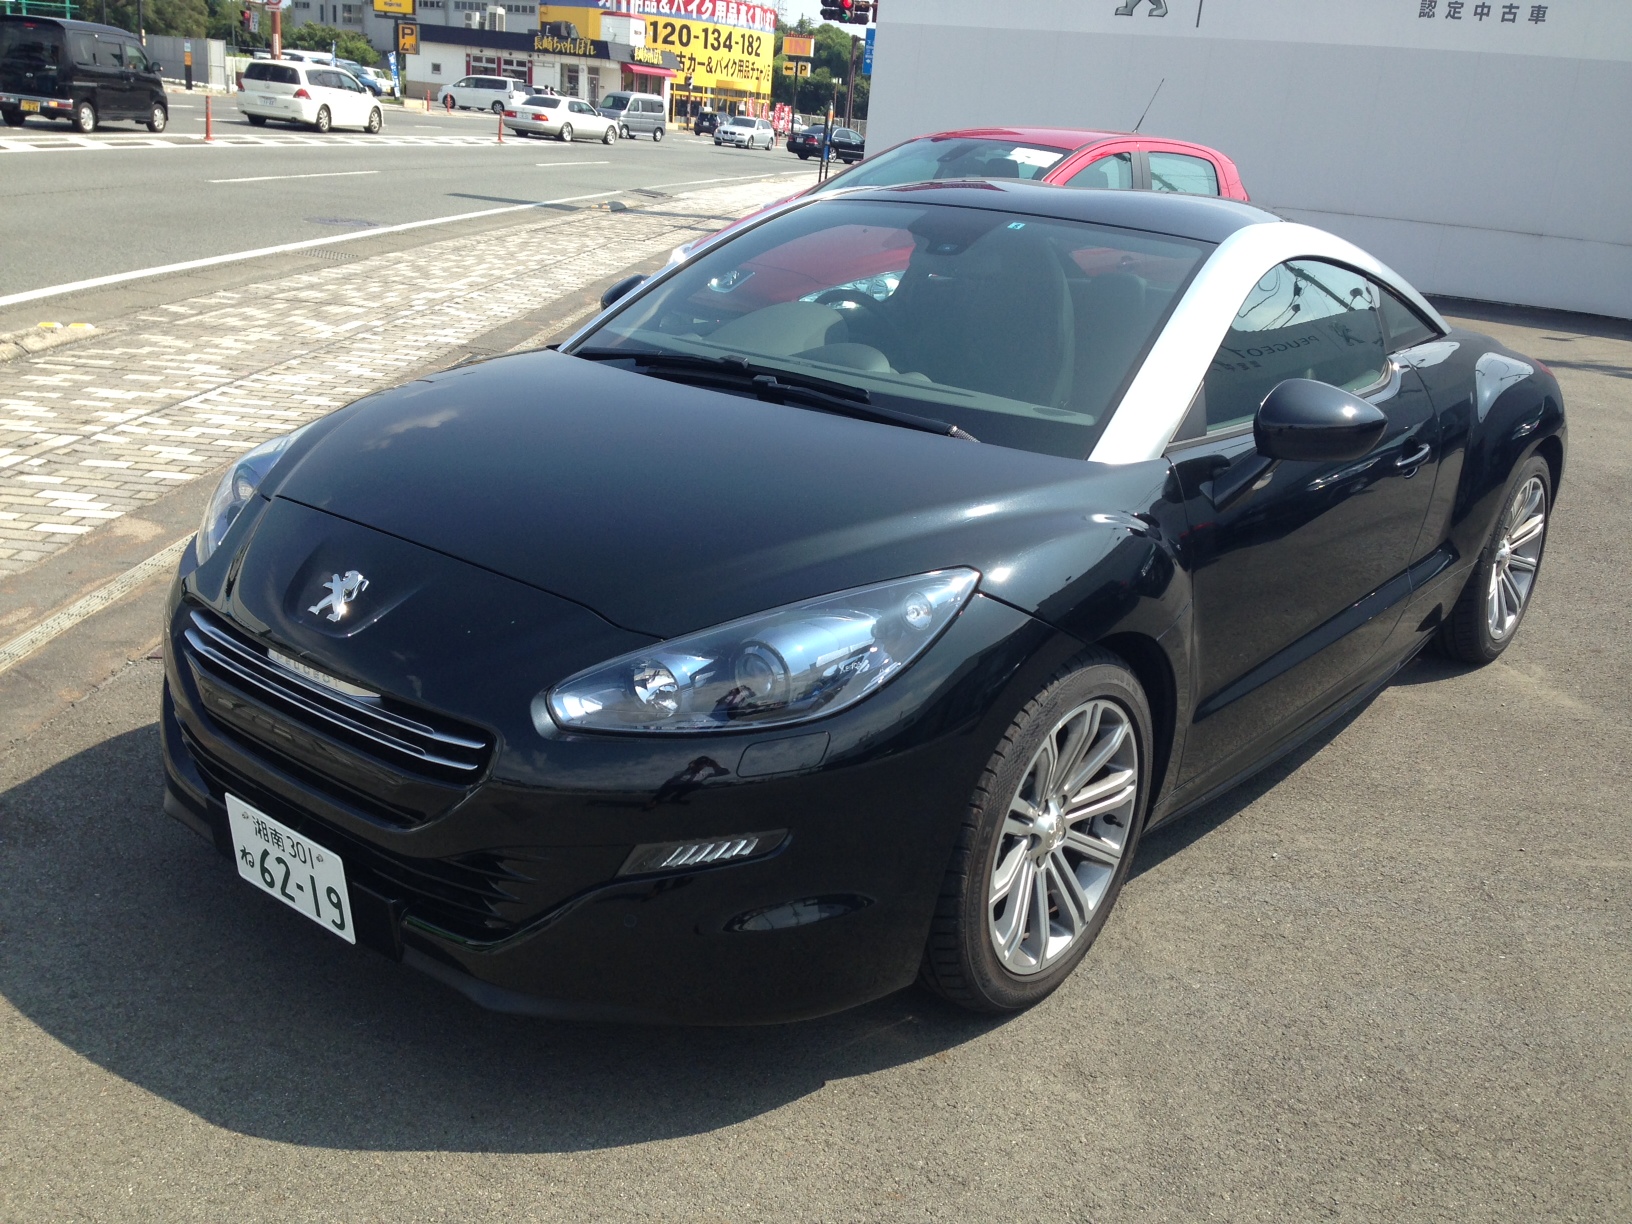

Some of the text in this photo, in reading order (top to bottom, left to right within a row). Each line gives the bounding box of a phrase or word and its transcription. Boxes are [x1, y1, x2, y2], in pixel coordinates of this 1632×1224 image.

[1418, 0, 1549, 25] 認定中古車
[401, 26, 414, 39] P
[645, 20, 762, 57] 120-134-182
[534, 35, 597, 56] 長崎ちゃんぽん
[789, 39, 806, 55] IN
[800, 64, 807, 75] P
[240, 845, 346, 931] ね 62-19
